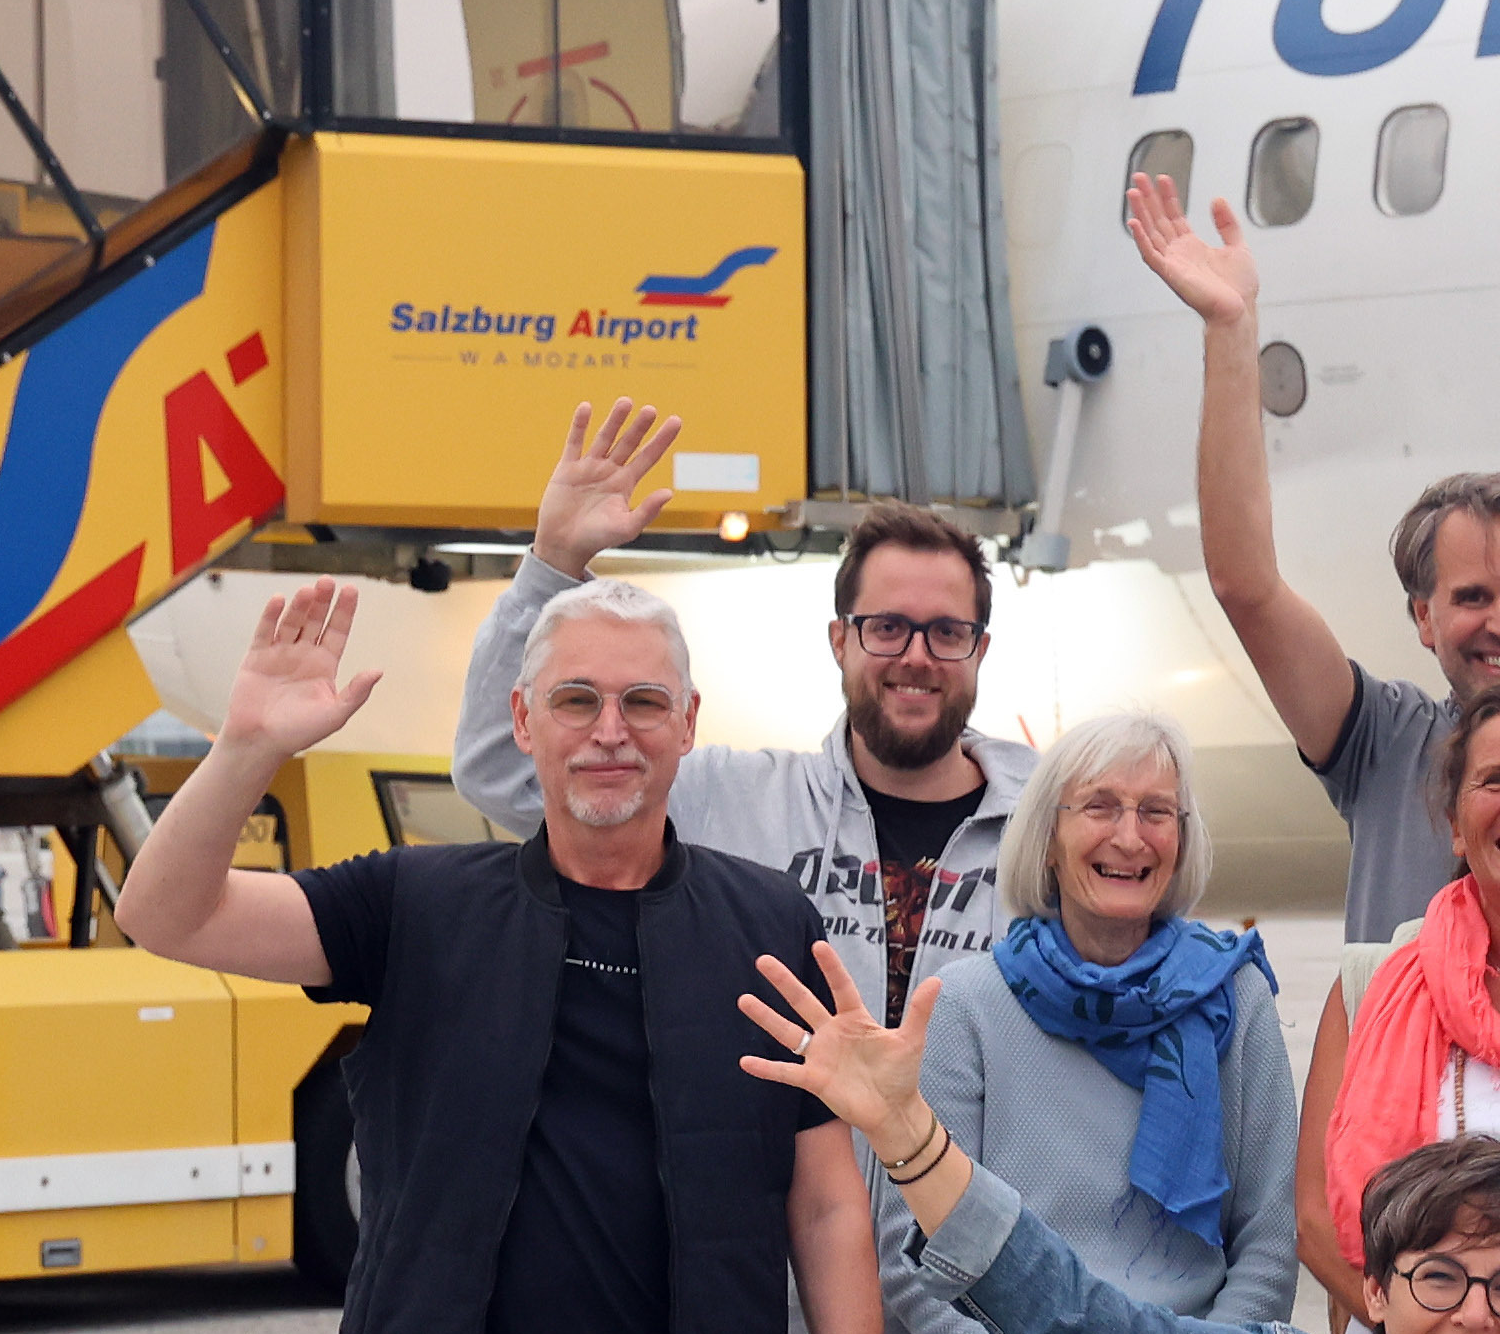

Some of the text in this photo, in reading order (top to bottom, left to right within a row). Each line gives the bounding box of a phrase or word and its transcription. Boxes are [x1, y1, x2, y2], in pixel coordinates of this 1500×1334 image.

[390, 303, 697, 344] Salzburg Airport
[523, 352, 631, 368] MOZART
